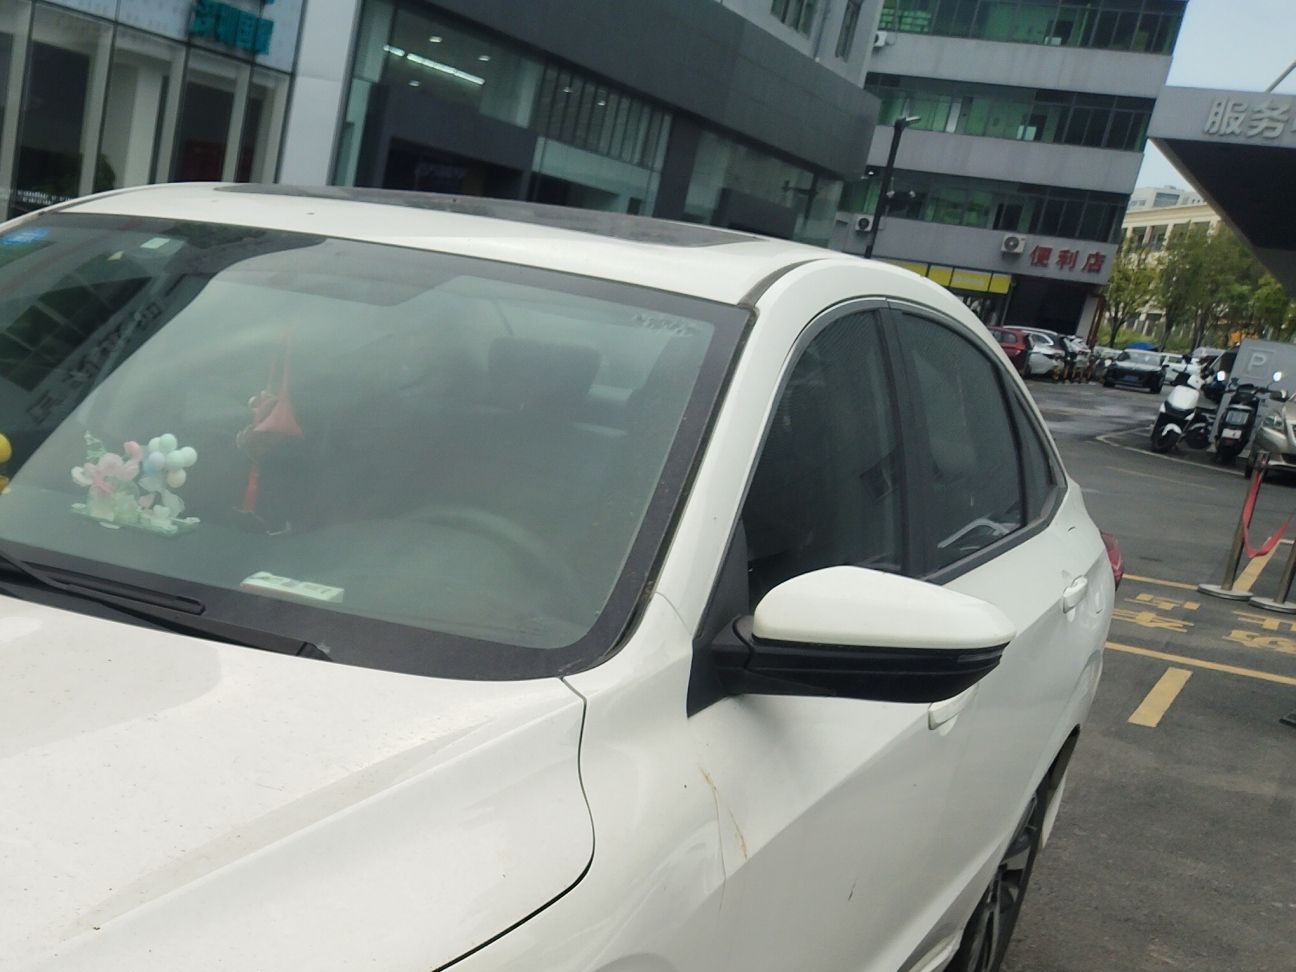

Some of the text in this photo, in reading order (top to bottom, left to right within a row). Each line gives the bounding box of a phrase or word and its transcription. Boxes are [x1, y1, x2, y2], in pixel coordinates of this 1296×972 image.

[1203, 97, 1296, 139] 服务
[1029, 245, 1107, 273] 便利店
